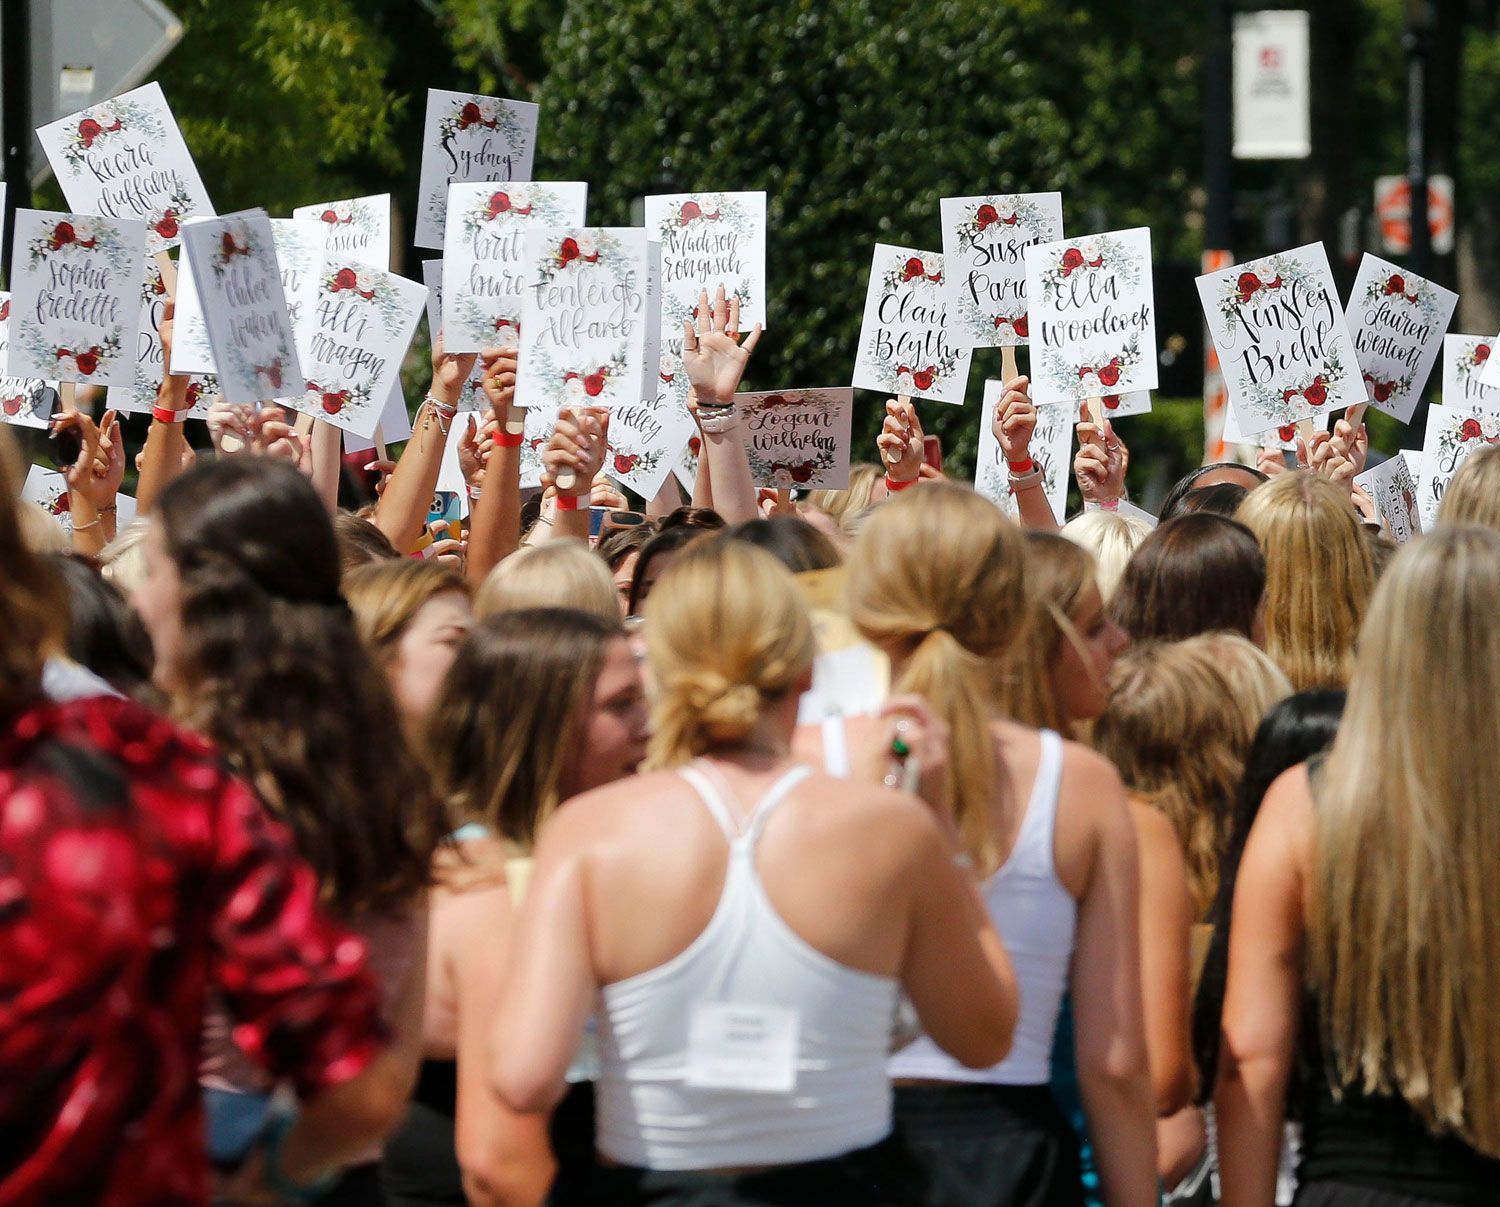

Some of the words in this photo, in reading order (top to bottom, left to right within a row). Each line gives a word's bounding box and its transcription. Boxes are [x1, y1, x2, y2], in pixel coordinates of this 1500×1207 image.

[441, 134, 514, 181] Sydney
[878, 293, 947, 327] Clair
[1054, 272, 1121, 311] Ella
[1220, 279, 1338, 349] Tinsley
[1364, 301, 1431, 345] Lauren
[1231, 320, 1342, 384] Brehl
[749, 411, 834, 435] Logan
